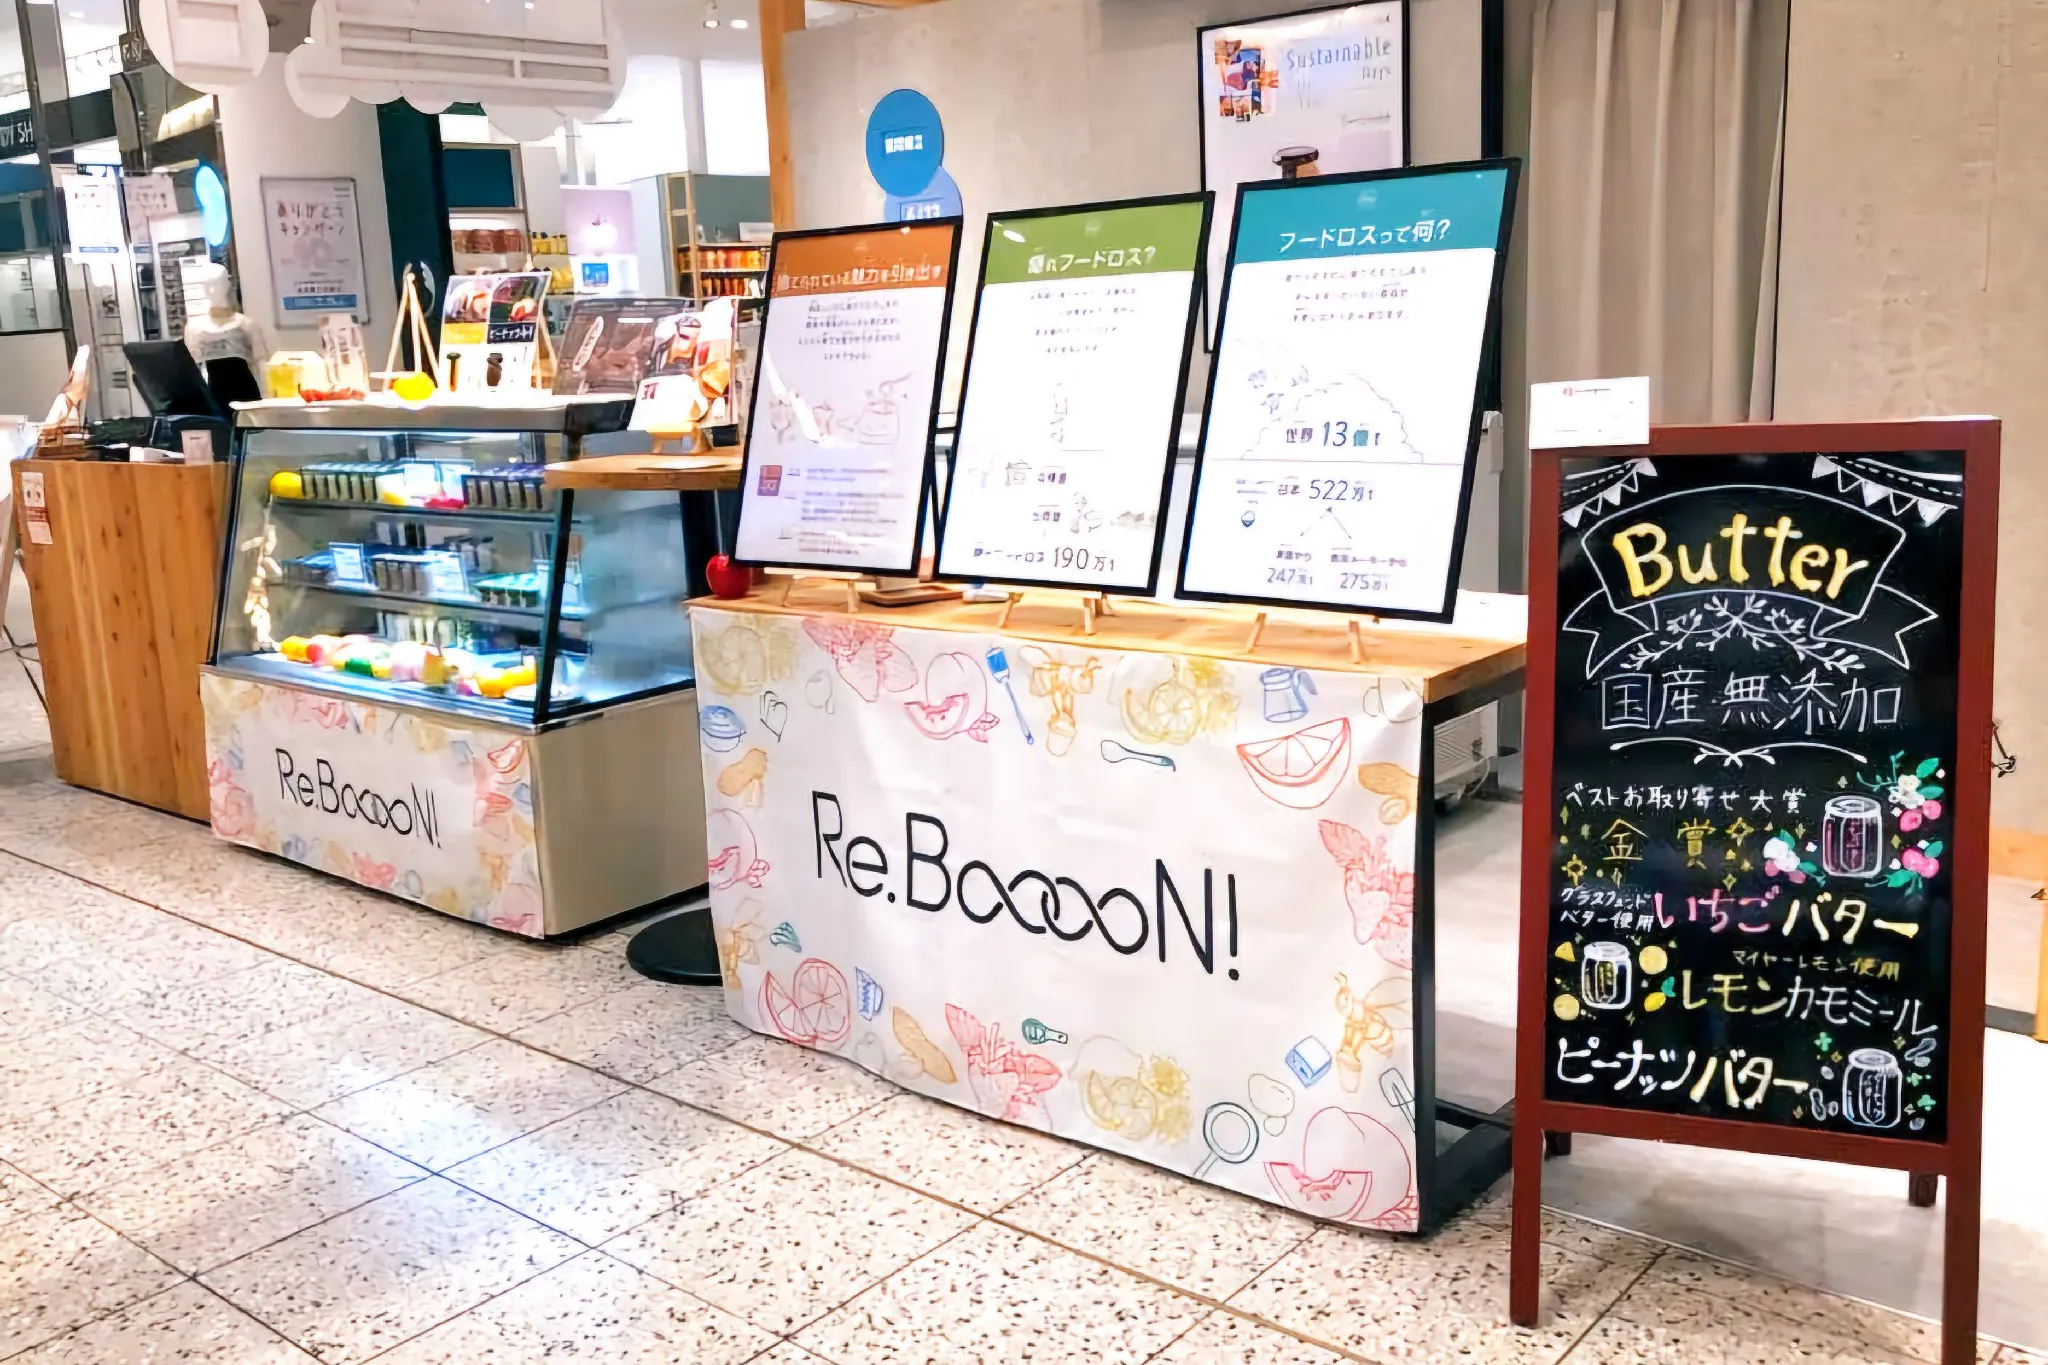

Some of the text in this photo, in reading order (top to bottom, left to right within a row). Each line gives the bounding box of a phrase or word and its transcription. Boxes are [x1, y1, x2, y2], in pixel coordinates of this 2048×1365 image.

[1279, 218, 1451, 253] フードロスって何?
[1612, 513, 1869, 599] Butter
[1682, 969, 1938, 1035] レモンカモミール
